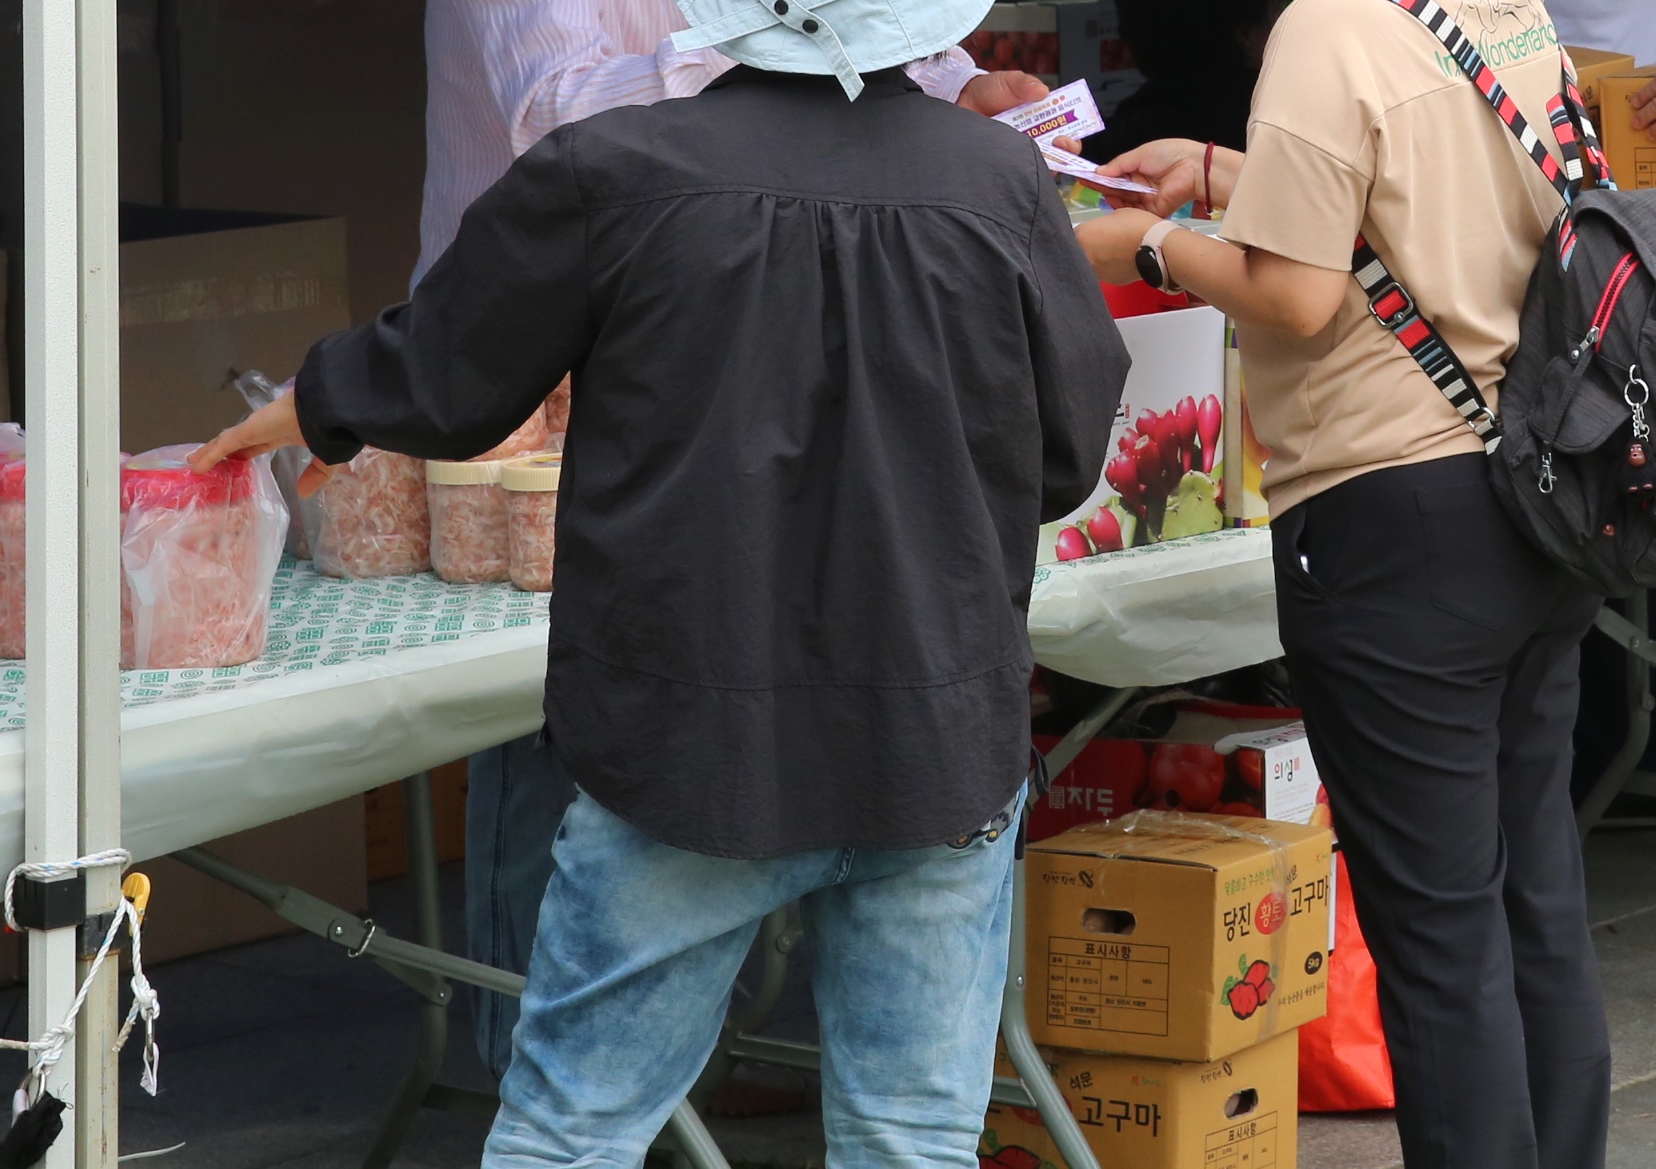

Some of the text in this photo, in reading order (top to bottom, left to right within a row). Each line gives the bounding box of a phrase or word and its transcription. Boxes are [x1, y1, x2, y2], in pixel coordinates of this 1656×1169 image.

[1026, 115, 1067, 137] 10,000원
[1274, 757, 1294, 781] 의성
[1067, 786, 1114, 817] 자두
[1223, 875, 1329, 941] 당진 황토 고구마
[1085, 942, 1131, 959] 표시사항
[1069, 1071, 1093, 1090] 석문
[1078, 1096, 1162, 1137] 고구마
